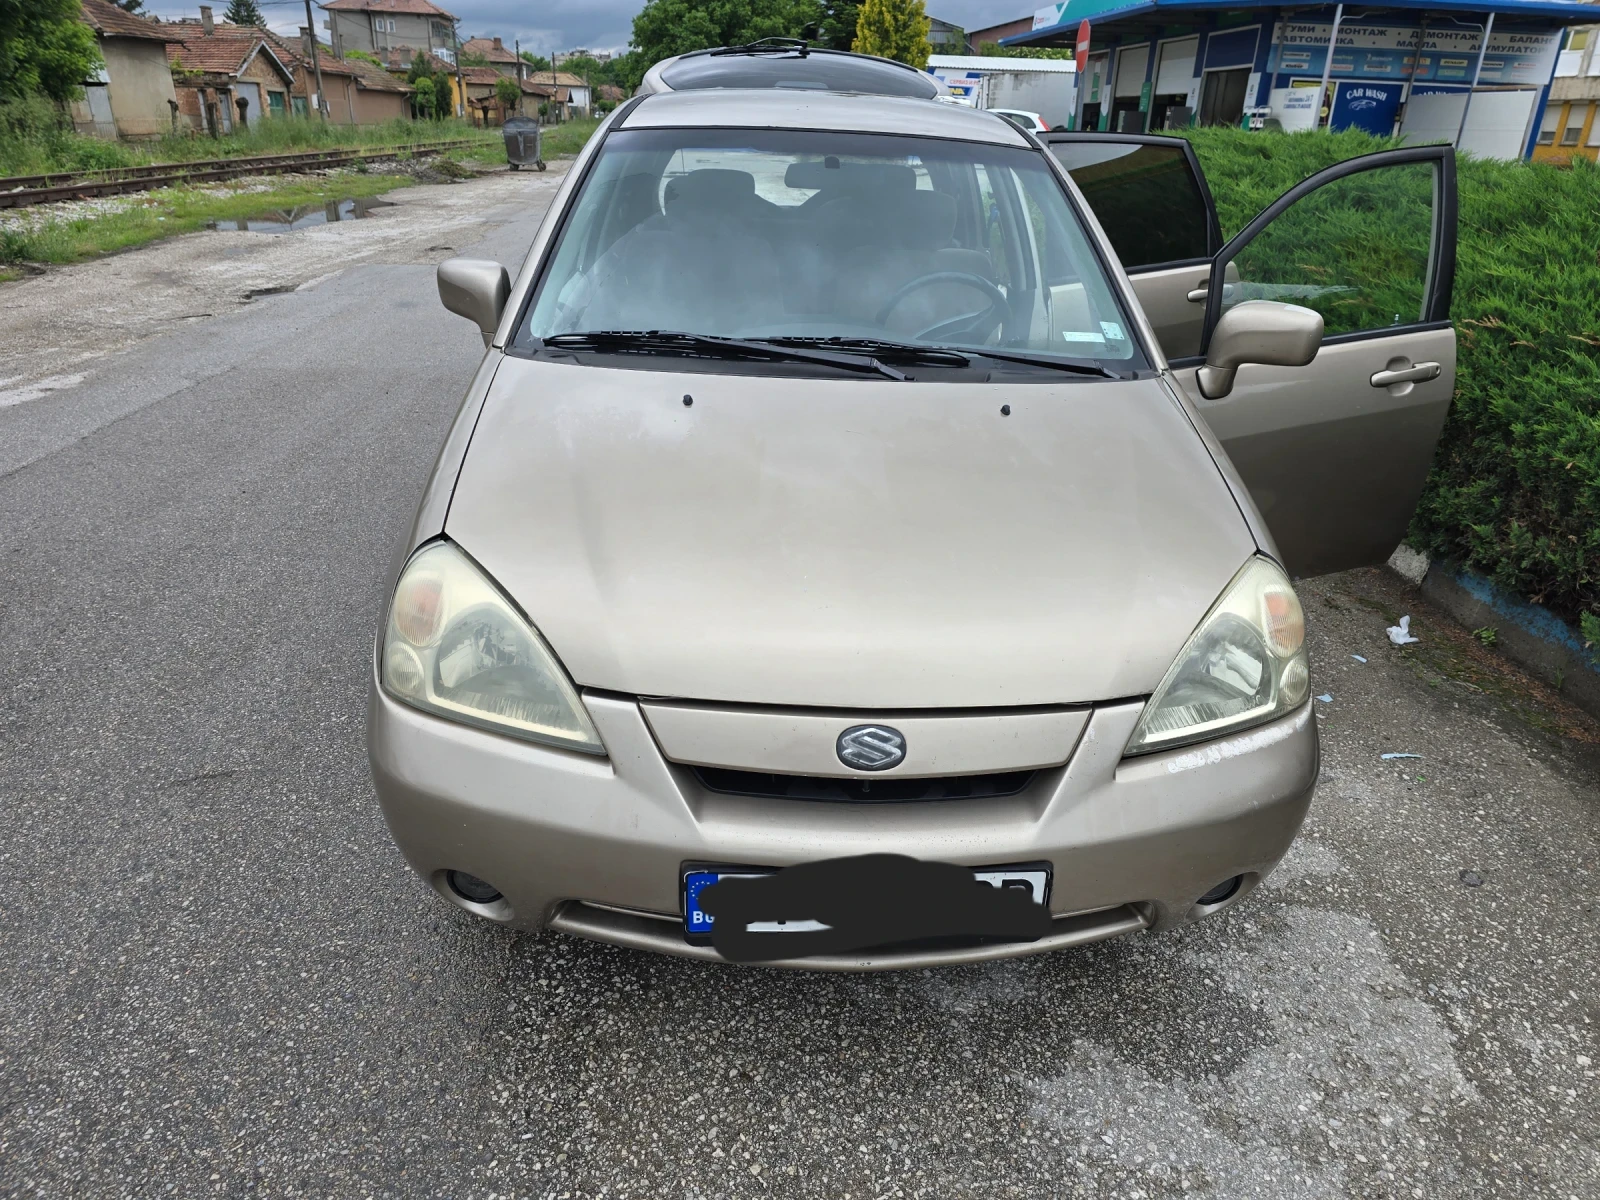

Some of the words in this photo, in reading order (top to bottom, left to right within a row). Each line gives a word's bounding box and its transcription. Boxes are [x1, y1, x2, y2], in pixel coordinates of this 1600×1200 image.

[1410, 29, 1480, 41] ДМОНТАЖ
[1346, 88, 1364, 99] CAR
[1365, 88, 1388, 101] WASH
[692, 910, 715, 924] BG
